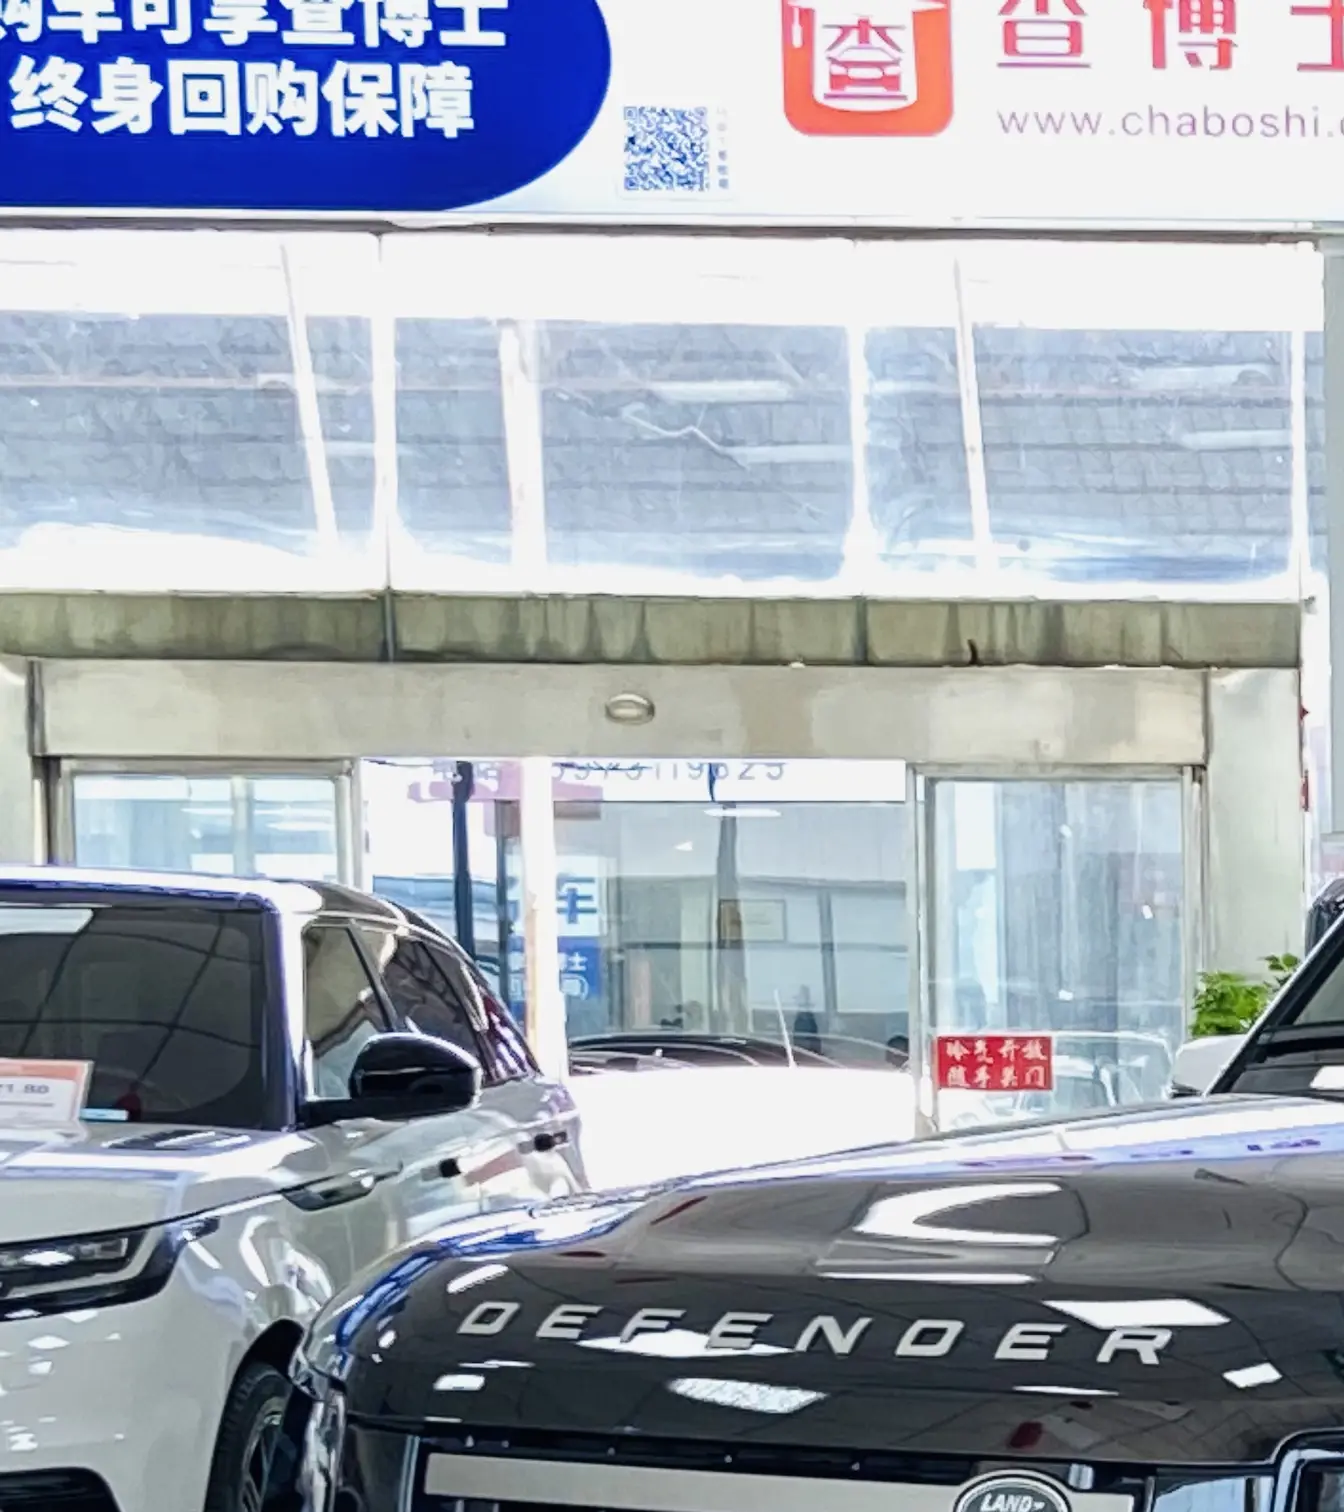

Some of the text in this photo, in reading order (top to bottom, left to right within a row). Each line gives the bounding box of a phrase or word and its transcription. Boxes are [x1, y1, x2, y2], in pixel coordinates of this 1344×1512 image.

[8, 54, 475, 139] 终身回购保障
[456, 1300, 1174, 1365] DEFENDER
